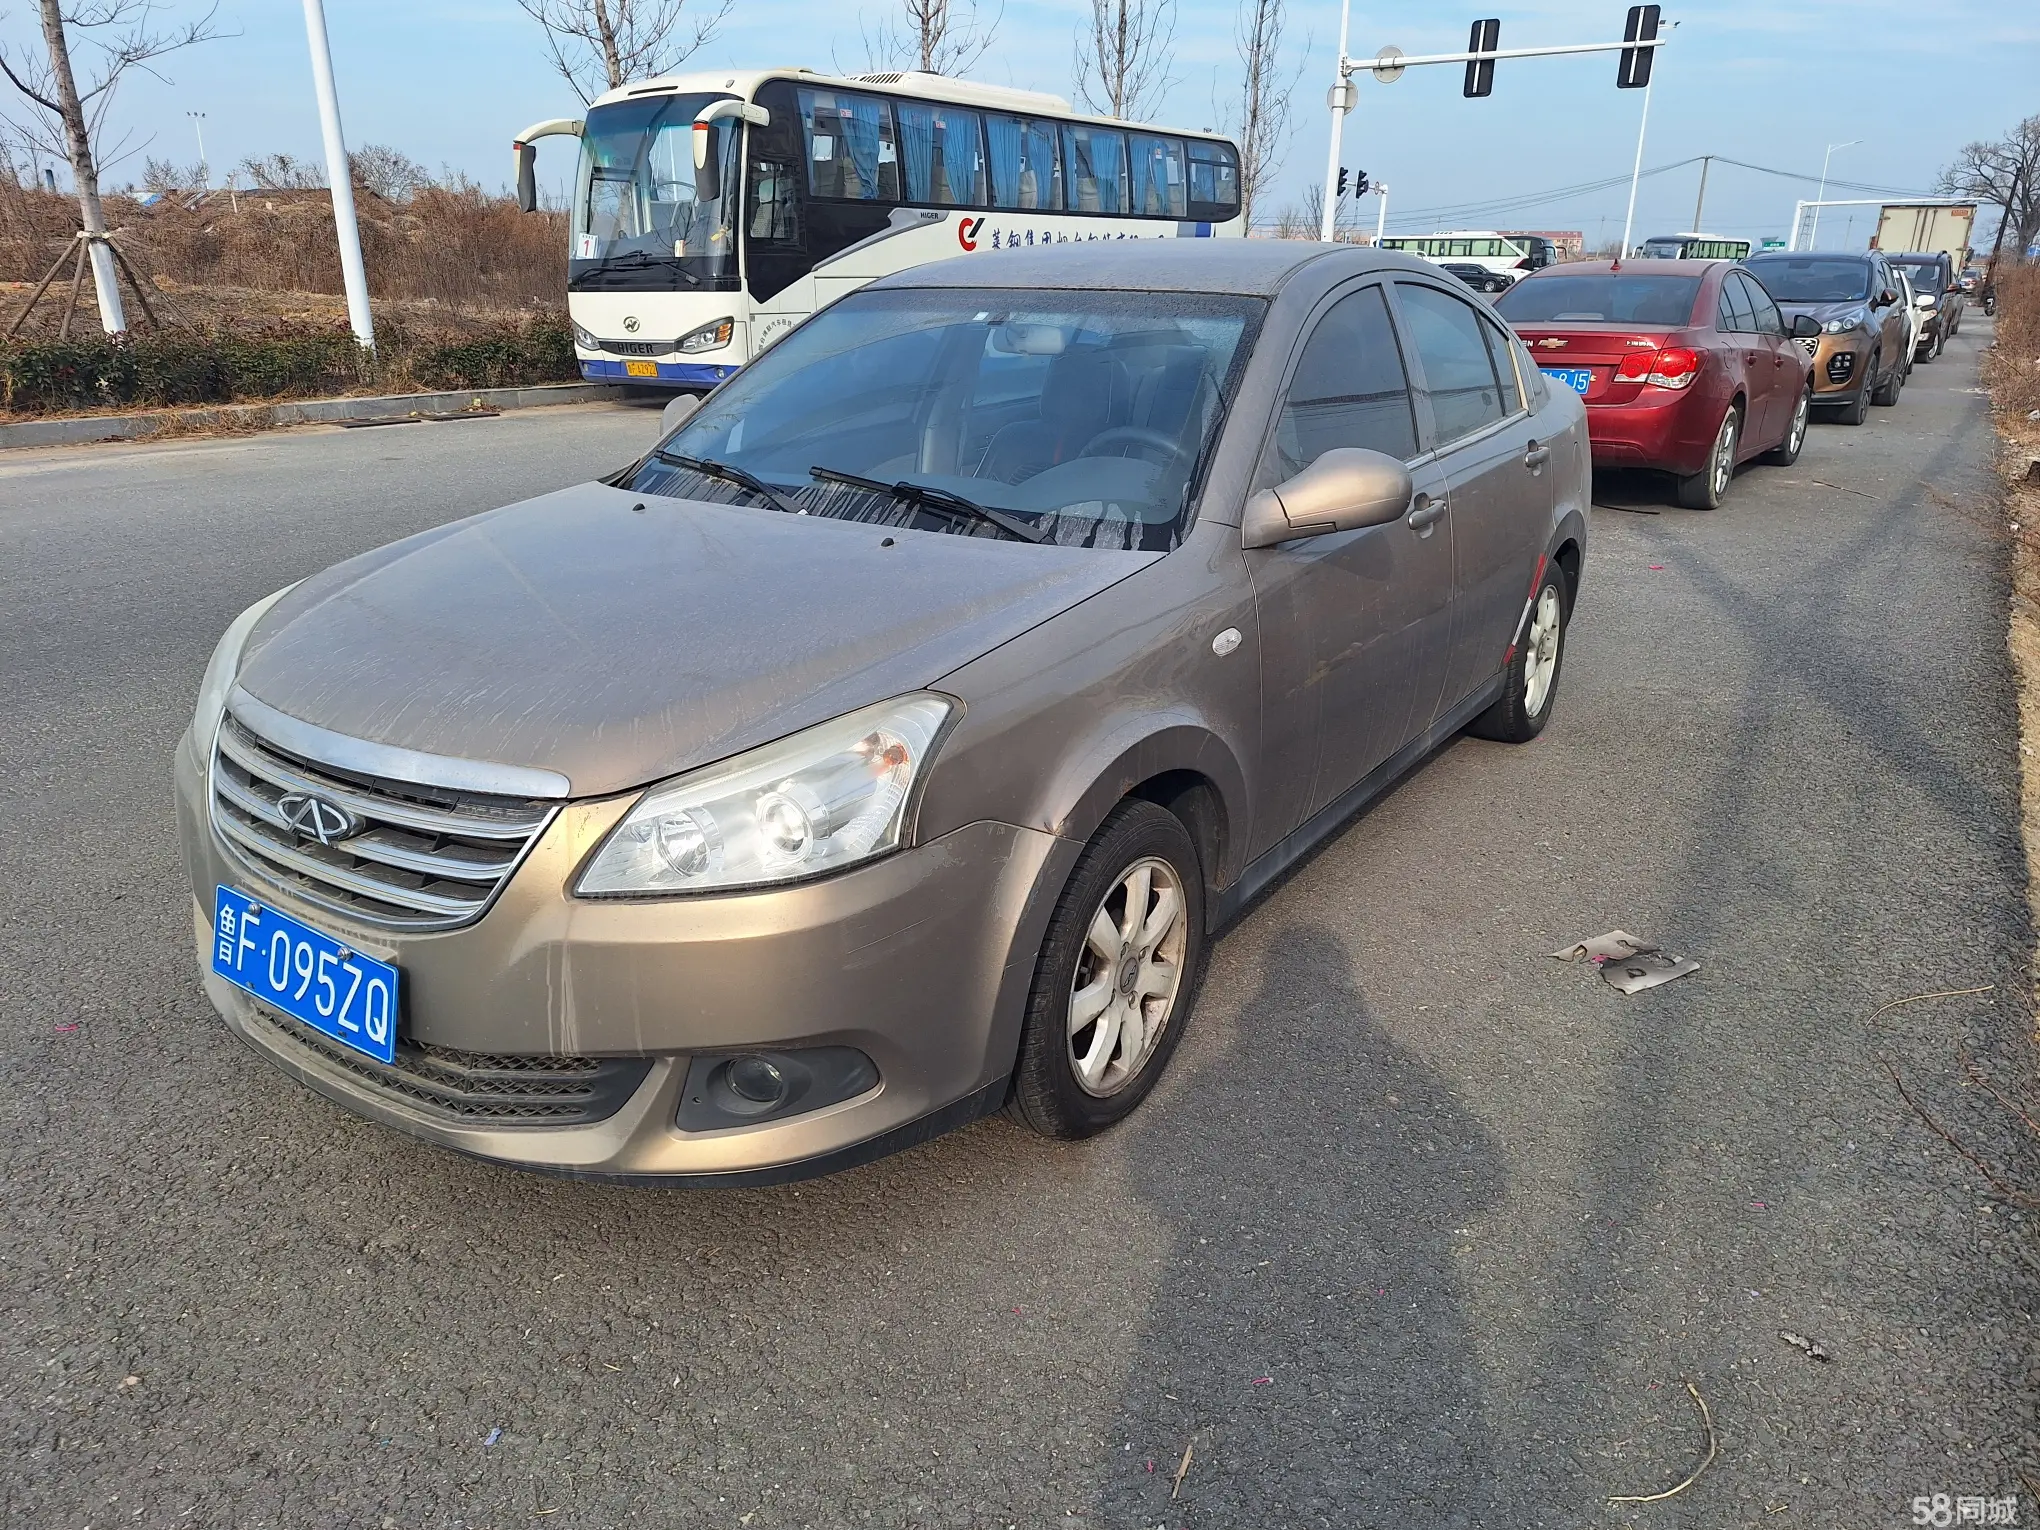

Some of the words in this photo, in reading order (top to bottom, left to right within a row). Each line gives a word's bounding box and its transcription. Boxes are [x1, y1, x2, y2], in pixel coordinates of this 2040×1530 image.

[920, 212, 939, 220] HIGER
[583, 239, 591, 257] 1
[617, 343, 654, 354] HIGER
[217, 903, 389, 1046] 鲁F·095ZQ
